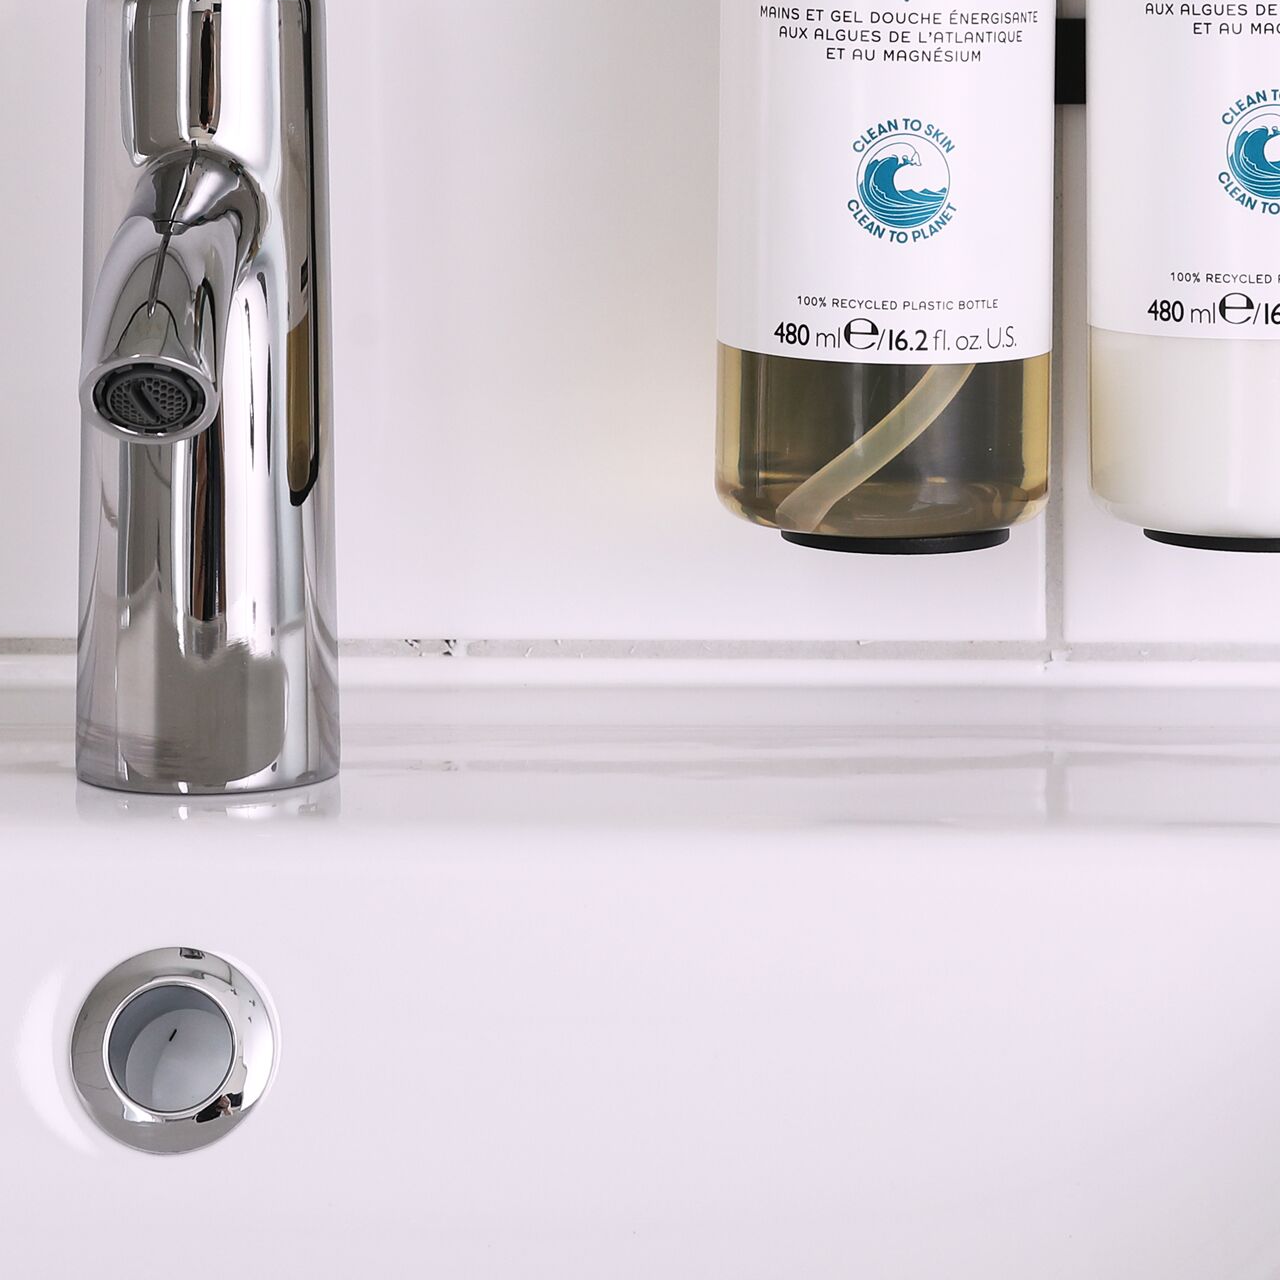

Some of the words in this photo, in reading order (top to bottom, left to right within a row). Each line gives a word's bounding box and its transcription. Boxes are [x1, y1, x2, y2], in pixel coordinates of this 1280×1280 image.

[759, 5, 801, 21] MAINS
[805, 8, 824, 22] ET
[830, 9, 864, 24] GEL
[869, 10, 943, 25] DOUCHE
[948, 8, 1039, 25] ÉNERGISANTE
[1144, 2, 1175, 16] AUX
[1179, 3, 1249, 17] ALGUES
[1255, 3, 1279, 17] DE
[778, 26, 809, 40] AUX
[813, 28, 882, 43] ALGUES
[888, 30, 912, 44] DE
[1192, 22, 1212, 35] ET
[1219, 22, 1243, 35] AU
[826, 47, 846, 61] ET
[851, 48, 876, 62] AU
[882, 47, 982, 63] MAGNÉSIUM
[1221, 89, 1268, 126] CLEAN
[852, 119, 899, 154] CLEAN
[902, 118, 923, 131] TO
[924, 123, 956, 154] SKIN
[1217, 171, 1258, 211] CLEAN
[1260, 200, 1280, 215] TO
[846, 199, 886, 241] CLEAN
[888, 229, 909, 244] TO
[911, 202, 957, 243] PLANET
[1170, 271, 1201, 284] 100%
[1205, 272, 1273, 284] RECYCLED
[797, 295, 827, 309] 100%
[831, 297, 898, 311] RECYCLED
[902, 300, 954, 311] PLASTIC
[958, 298, 999, 310] BOTTLE
[1147, 299, 1185, 322] 480
[773, 321, 811, 346] 480
